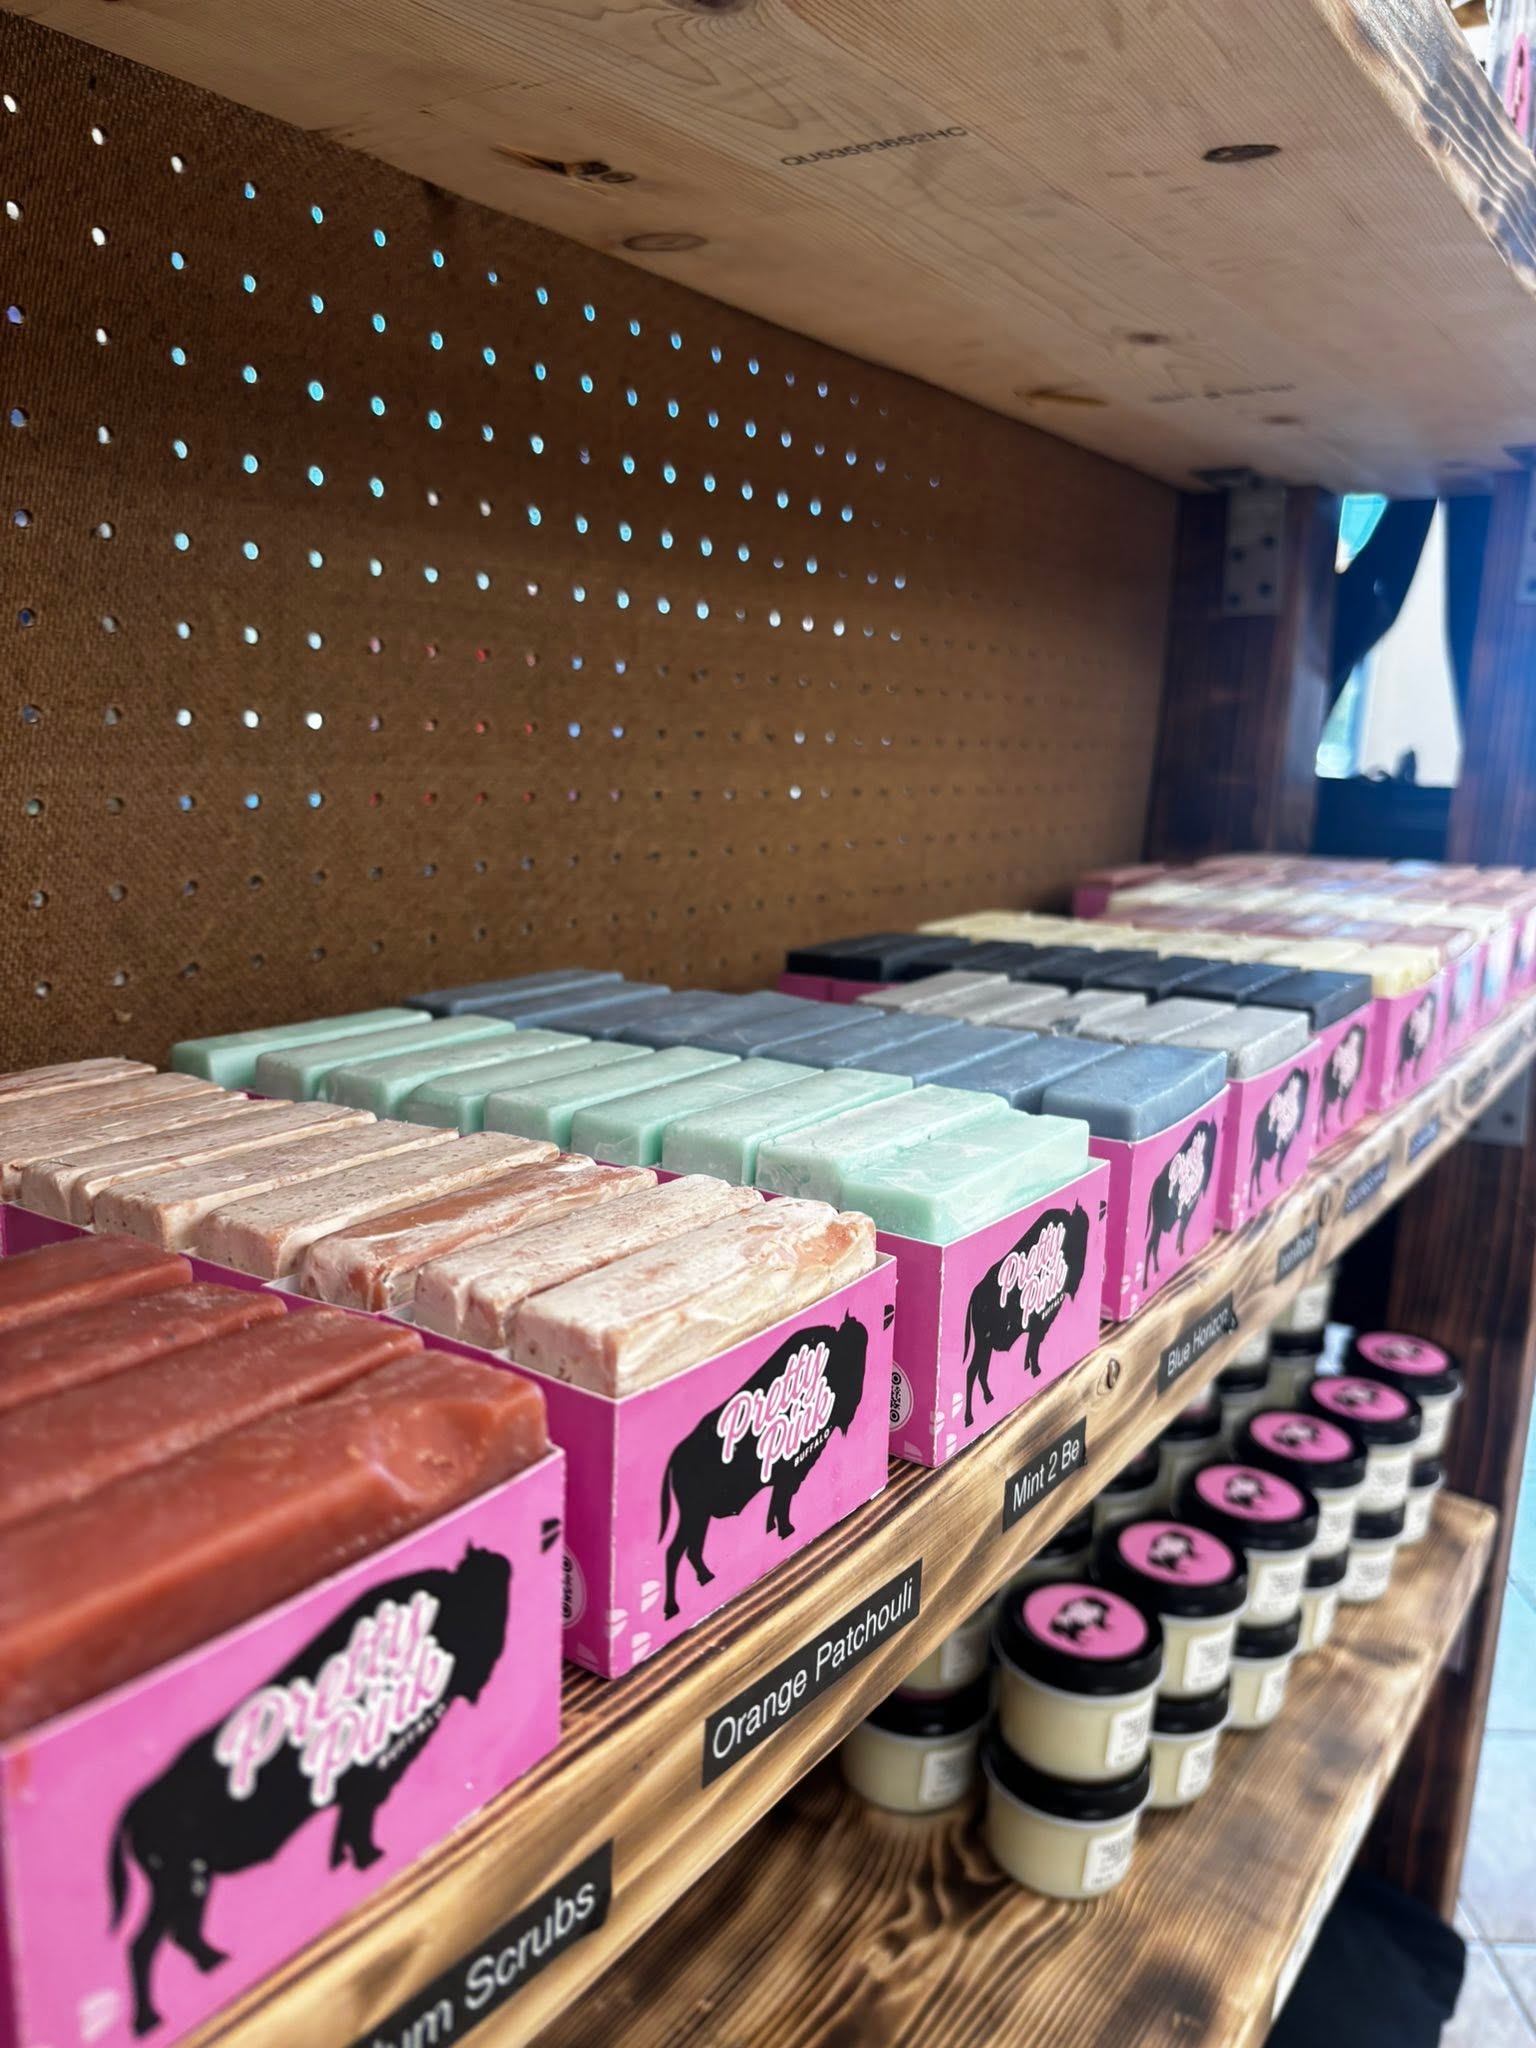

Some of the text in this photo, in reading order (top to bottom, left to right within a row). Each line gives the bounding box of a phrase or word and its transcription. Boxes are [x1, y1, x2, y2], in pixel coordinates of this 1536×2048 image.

[997, 1221, 1066, 1309] Pretty
[1020, 1250, 1069, 1329] Pink
[716, 1341, 830, 1464] Pretty
[1167, 1342, 1190, 1377] Blue
[756, 1375, 836, 1483] Pink
[793, 1427, 831, 1468] BUFFALO
[1013, 1439, 1080, 1512] Mint 2 Be
[213, 1590, 440, 1801] Pretty
[299, 1634, 455, 1807] Pink
[713, 1577, 913, 1759] Orange Patchouli
[464, 1882, 595, 2010] Scrubs
